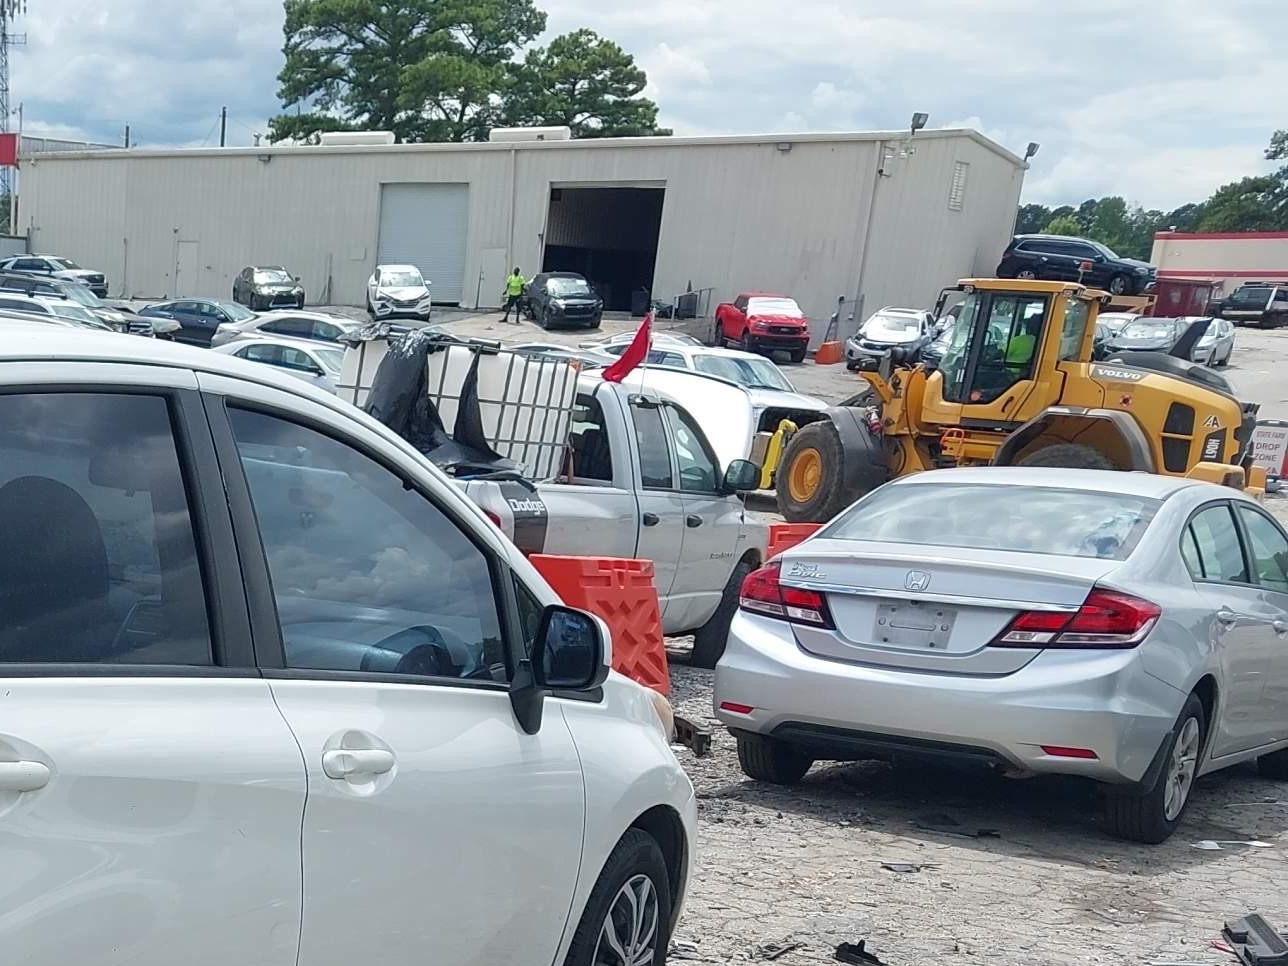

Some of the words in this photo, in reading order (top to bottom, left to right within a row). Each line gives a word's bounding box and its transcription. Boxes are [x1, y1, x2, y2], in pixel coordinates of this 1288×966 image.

[1097, 368, 1141, 380] VOLVO
[1255, 442, 1281, 452] DROP
[1255, 454, 1278, 462] ZONE
[508, 498, 545, 516] Dodge
